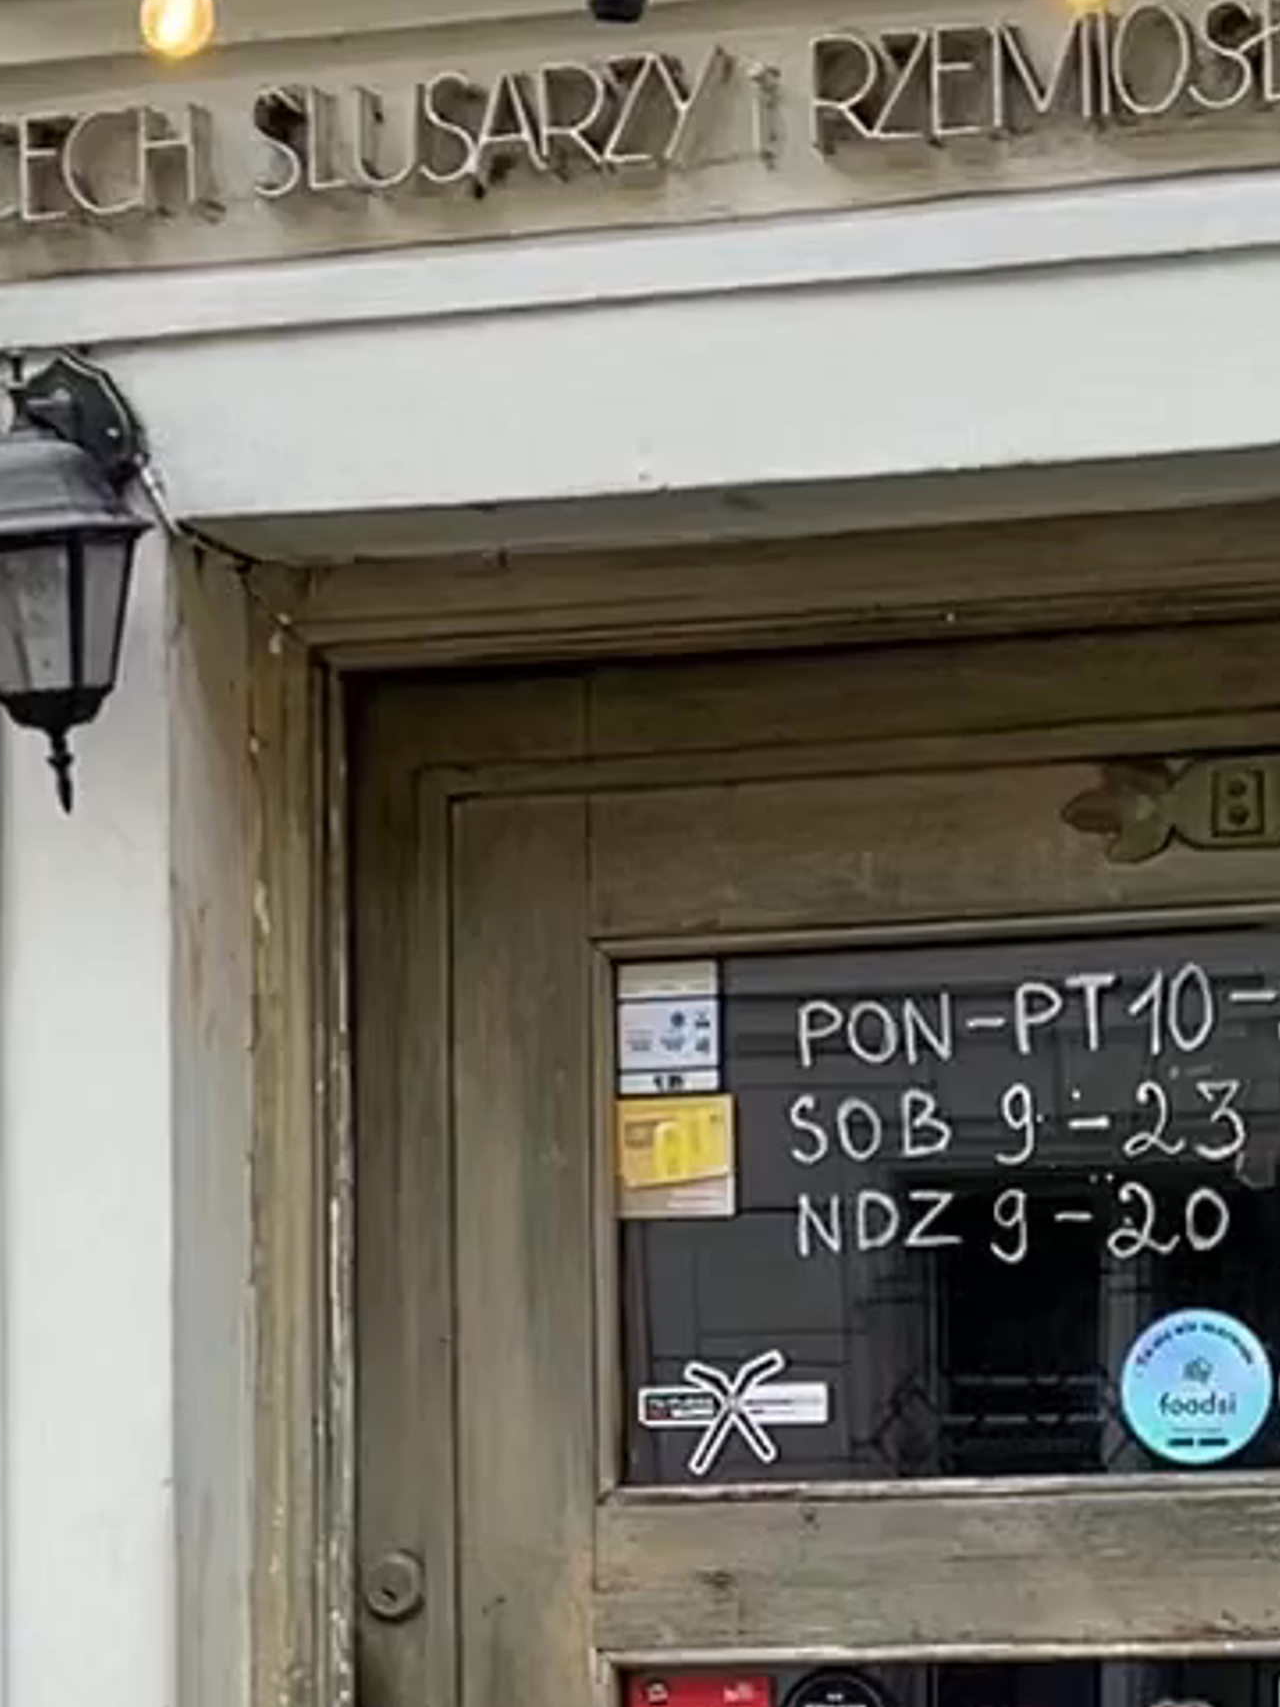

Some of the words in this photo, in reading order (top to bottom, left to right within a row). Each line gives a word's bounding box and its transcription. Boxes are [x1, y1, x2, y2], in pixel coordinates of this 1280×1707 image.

[797, 971, 1116, 1068] PON-PT
[790, 1089, 952, 1165] SOB
[797, 1189, 963, 1258] NDZ
[1159, 1391, 1238, 1416] foodsi
